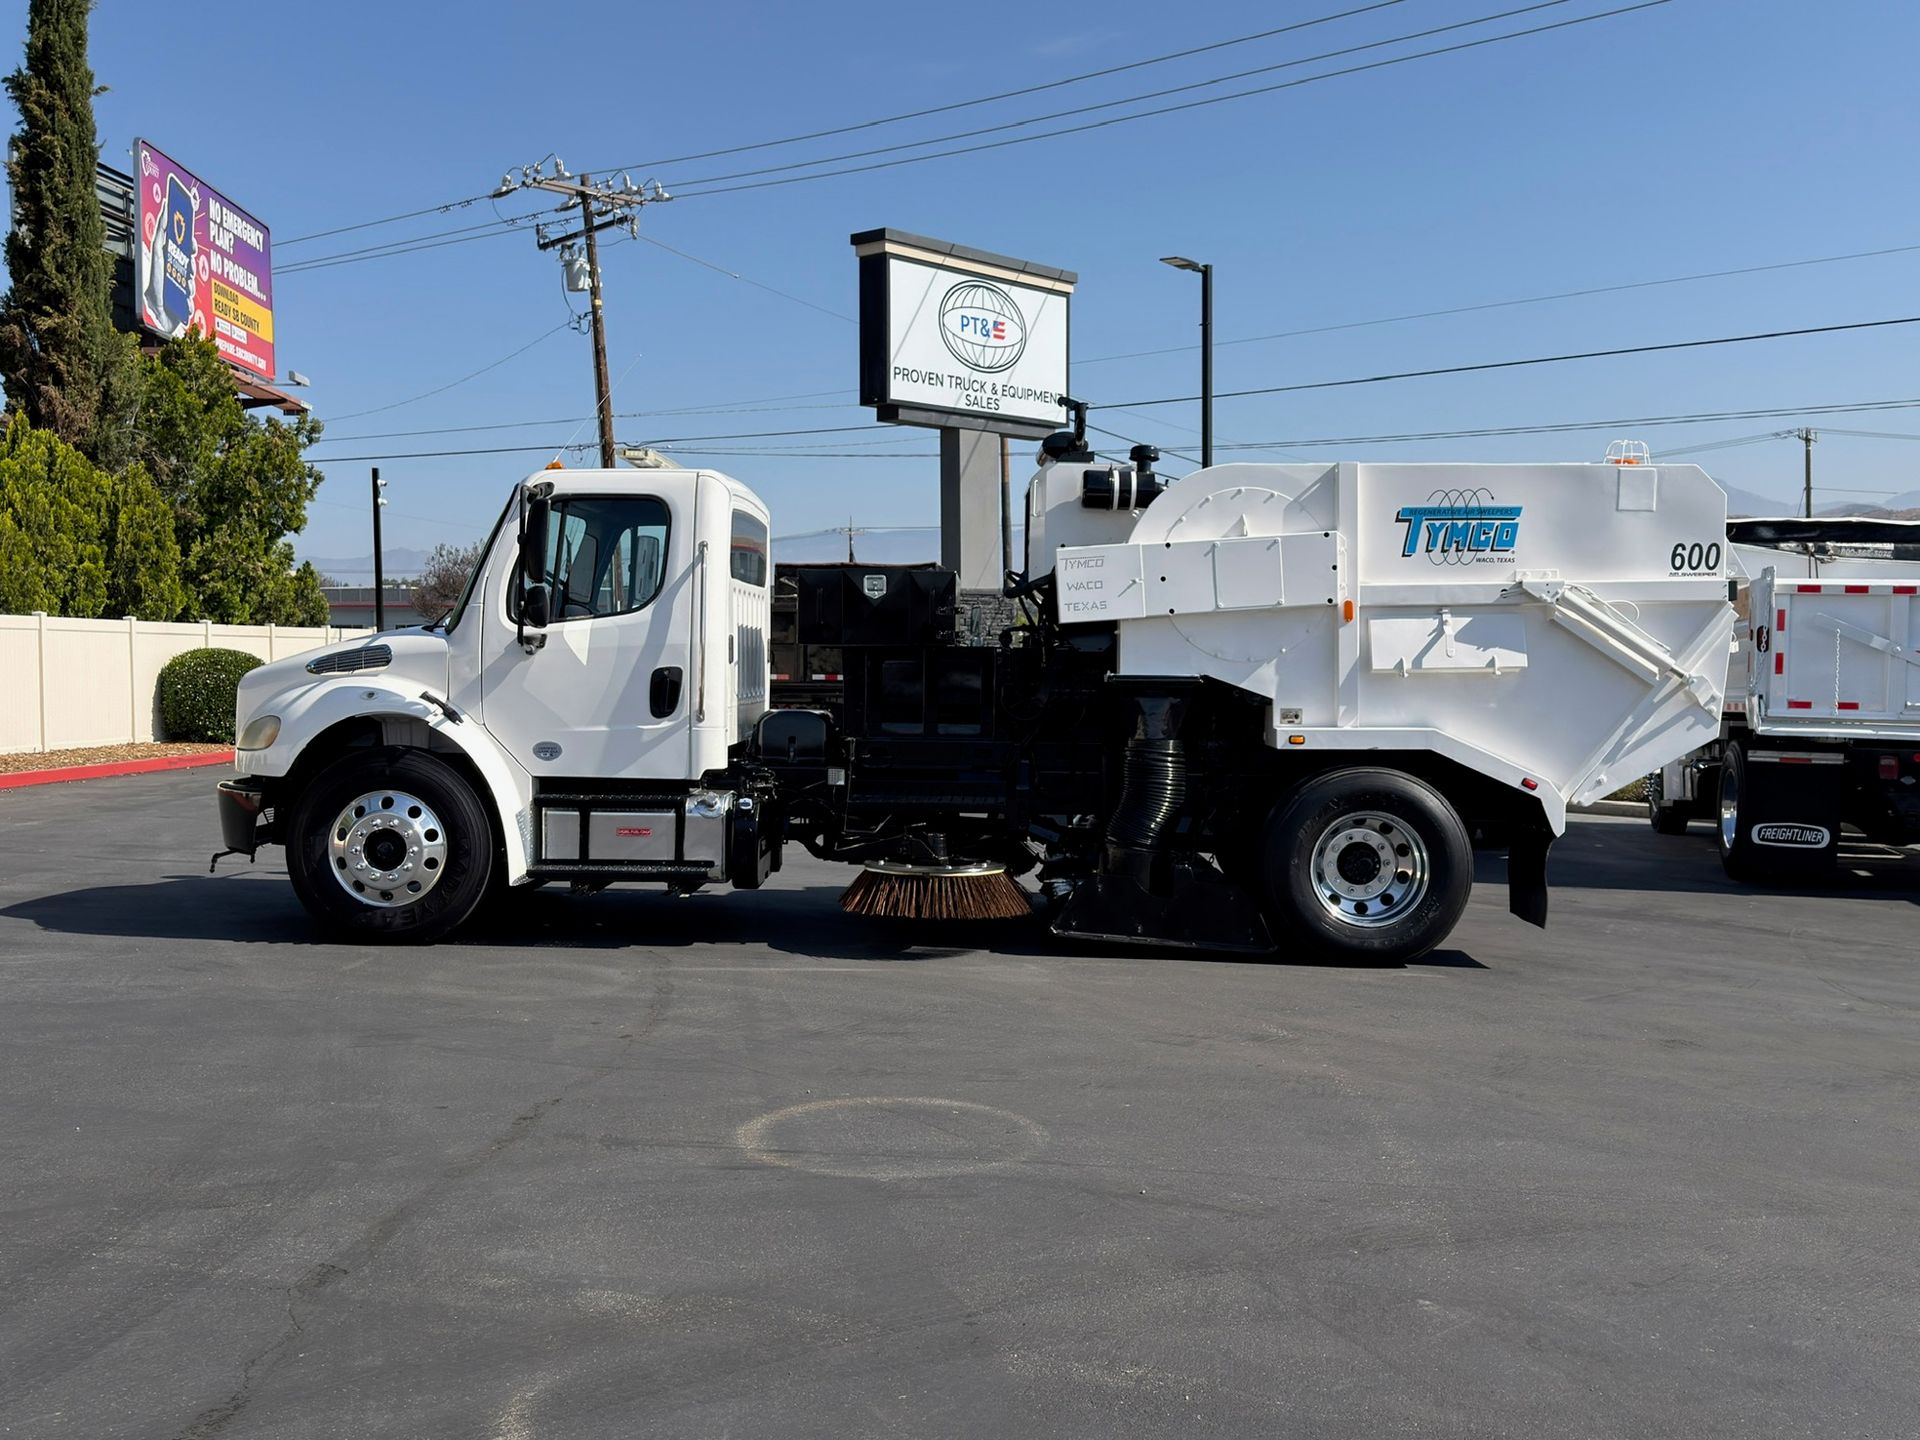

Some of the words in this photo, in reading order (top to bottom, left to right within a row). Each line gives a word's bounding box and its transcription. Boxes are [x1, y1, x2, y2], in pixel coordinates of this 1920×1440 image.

[209, 197, 222, 225] NO
[222, 206, 264, 253] EMERGENCY
[209, 220, 234, 255] PLAN?
[210, 249, 222, 275] NO
[214, 282, 239, 306] DOWNLOAD
[214, 298, 232, 319] READY
[232, 307, 240, 322] SB
[240, 311, 260, 334] COUNTY
[960, 314, 1006, 341] PT&E
[893, 366, 944, 387] PROVEN
[947, 375, 987, 395] TRUCK
[991, 382, 999, 396] &
[965, 393, 1000, 411] SALES
[1475, 507, 1514, 516] SWEEPERS
[1395, 505, 1523, 558] TYMCO
[1059, 555, 1105, 571] TYMCO
[1670, 542, 1721, 571] 600
[1066, 580, 1104, 591] WACO
[1064, 600, 1107, 612] TEXAS
[1759, 827, 1824, 842] FREIGHTLINER
